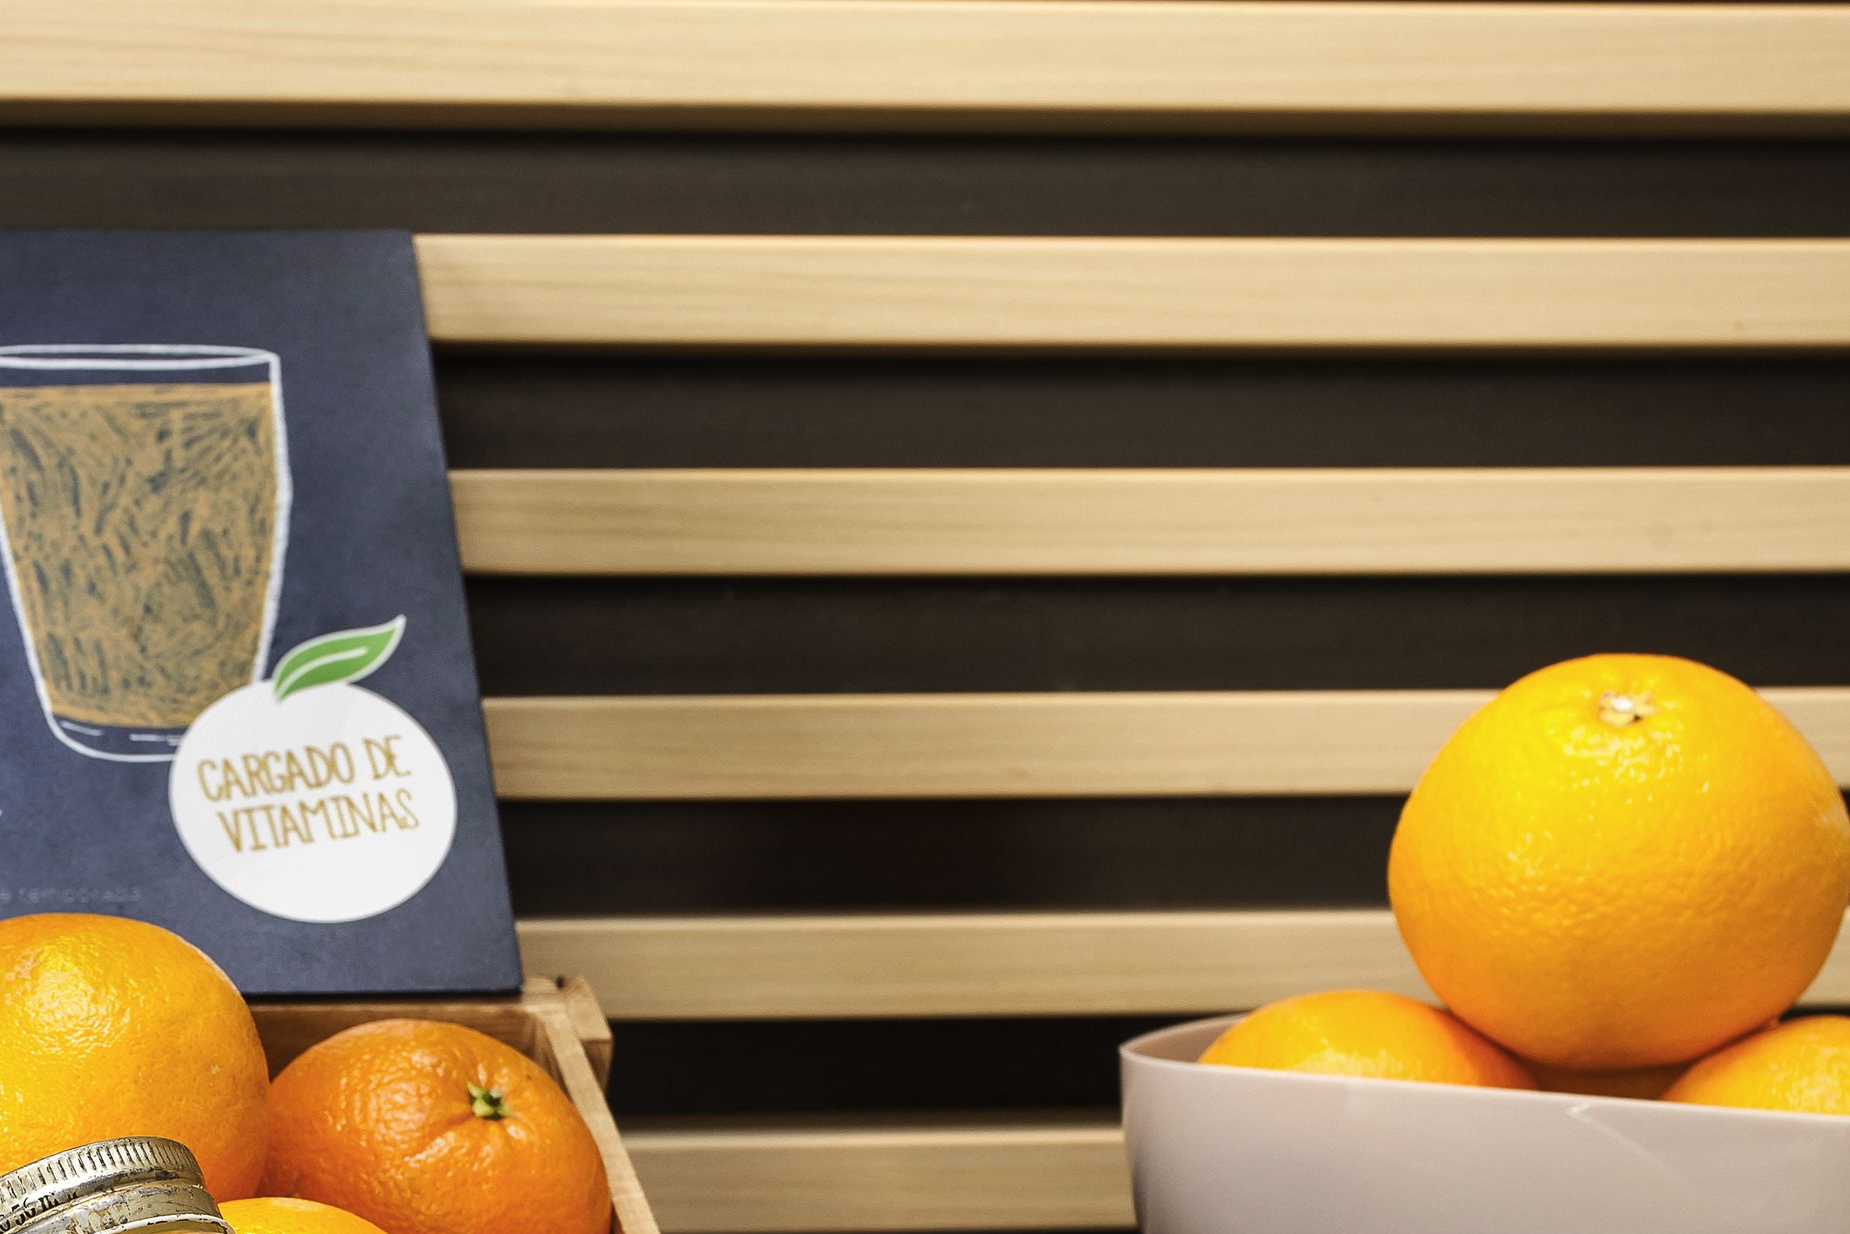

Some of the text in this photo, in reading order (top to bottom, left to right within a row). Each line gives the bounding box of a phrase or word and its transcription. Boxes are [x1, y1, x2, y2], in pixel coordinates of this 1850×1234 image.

[197, 735, 412, 802] CARGADO DE
[216, 787, 419, 854] VITAMINAS
